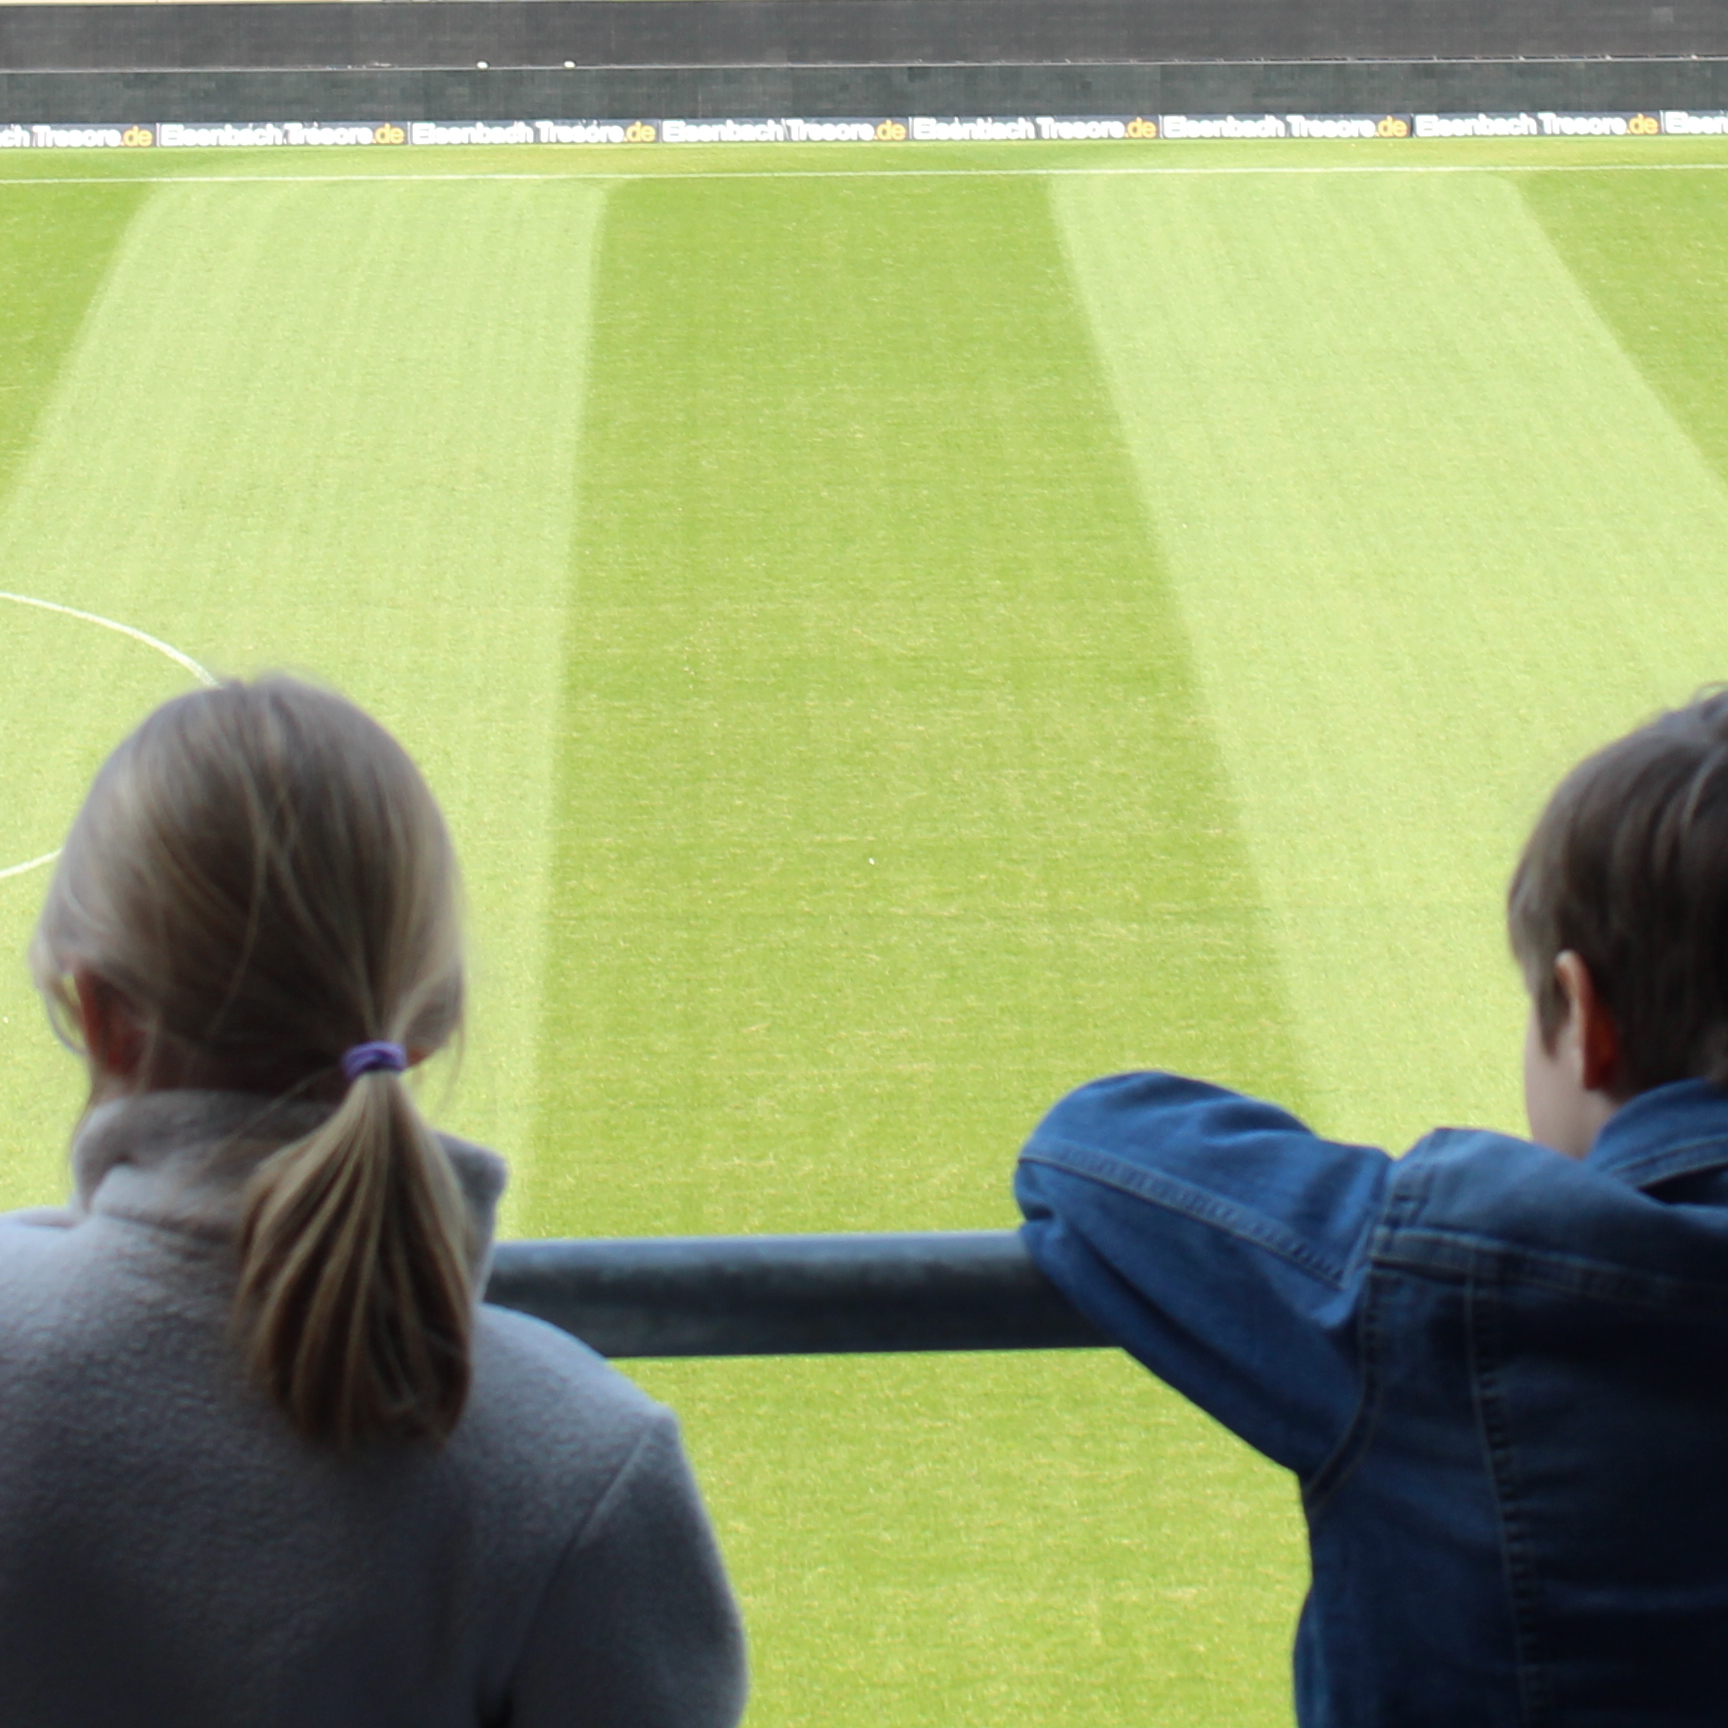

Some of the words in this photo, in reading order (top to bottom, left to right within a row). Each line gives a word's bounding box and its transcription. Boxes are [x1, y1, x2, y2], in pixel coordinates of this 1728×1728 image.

[286, 122, 406, 146] Tresore.de
[536, 121, 656, 144] Tresore.de
[787, 120, 907, 142] Tresore.de
[1038, 117, 1157, 140] Tresore.de
[1287, 115, 1409, 138] Tresore.de
[1541, 112, 1659, 135] Tresore.de
[33, 125, 153, 148] Tresore.de
